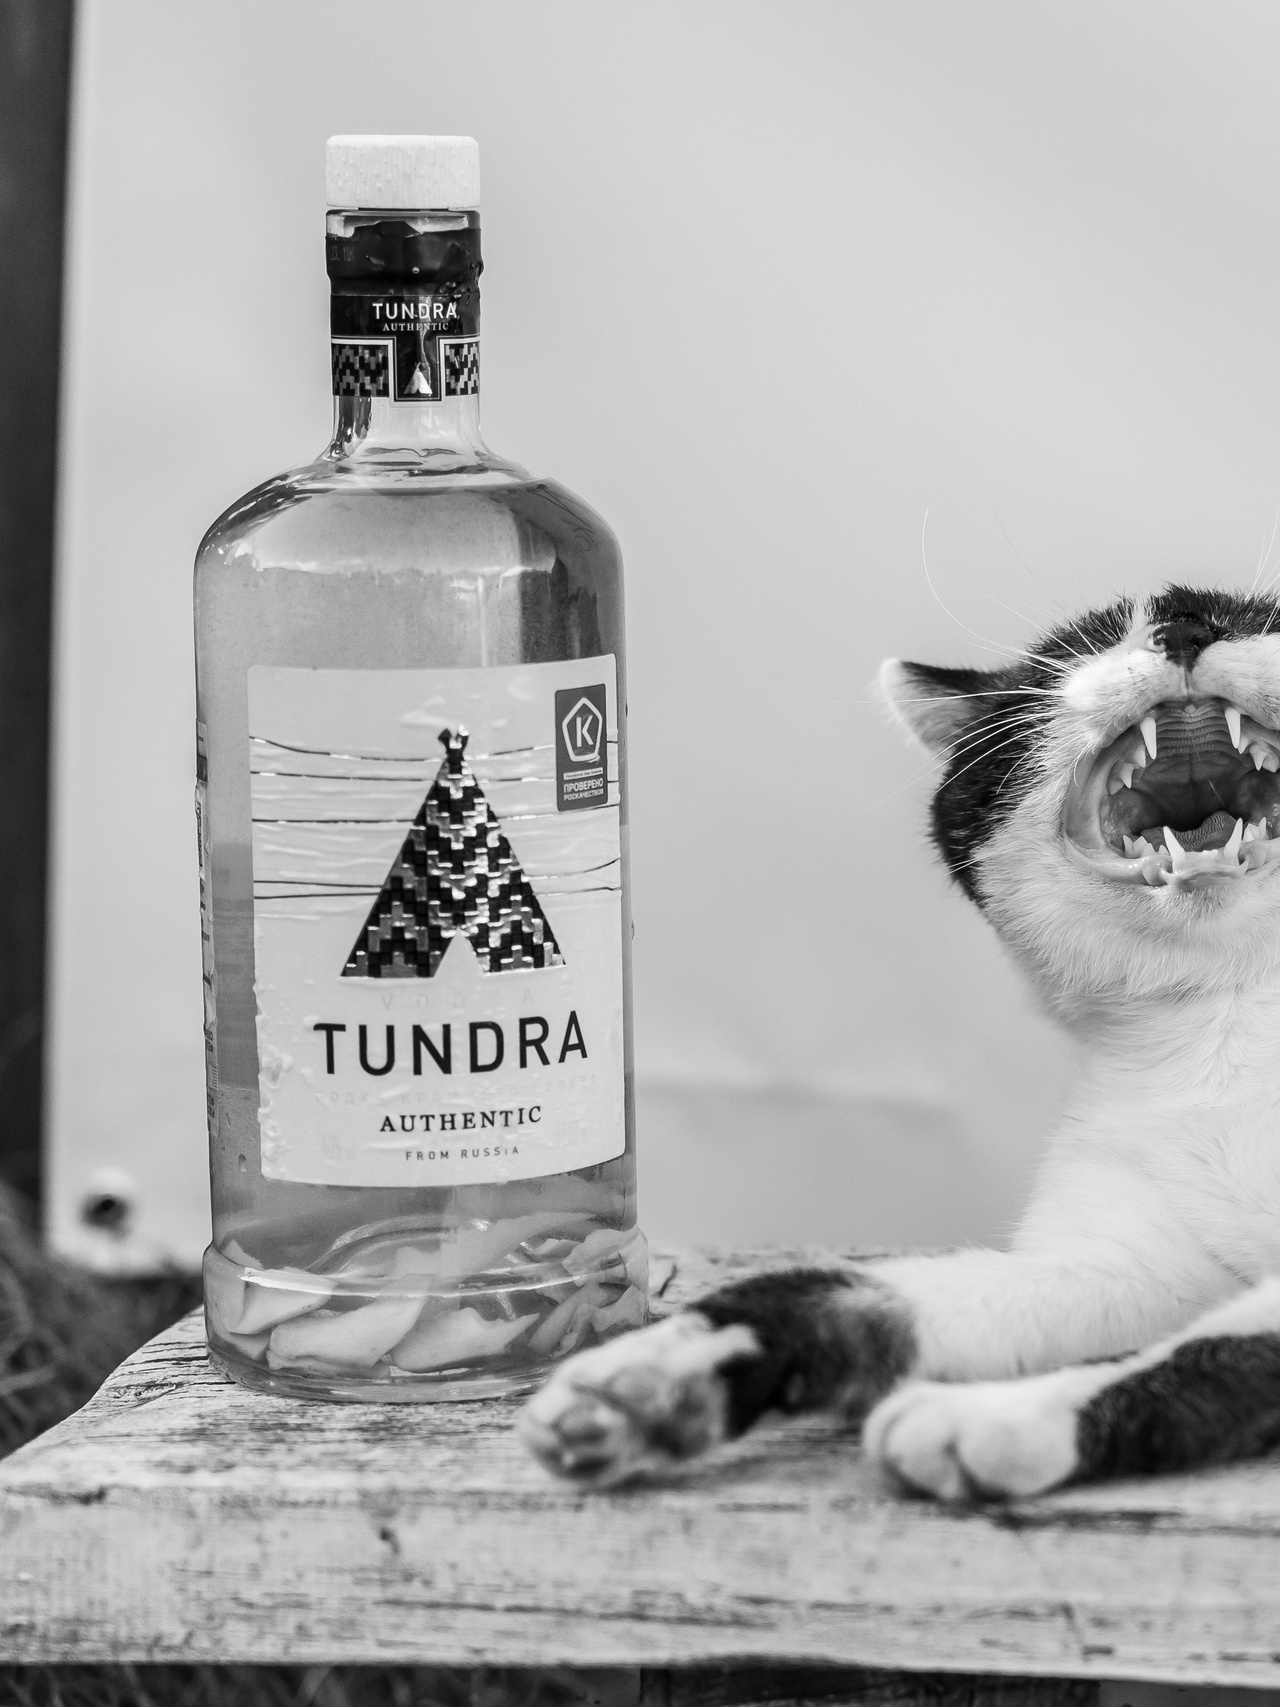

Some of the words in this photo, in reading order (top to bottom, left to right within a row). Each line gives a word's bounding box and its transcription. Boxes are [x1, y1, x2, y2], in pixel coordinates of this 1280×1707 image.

[372, 302, 457, 320] TUNDRA
[382, 322, 449, 332] AUTHENTIC
[563, 778, 604, 794] ПРОВЕРЕНО
[313, 1010, 588, 1077] TUNDRA
[379, 1105, 542, 1133] AUTHENTIC
[405, 1150, 450, 1162] FROM
[460, 1146, 520, 1160] RUSSIA
